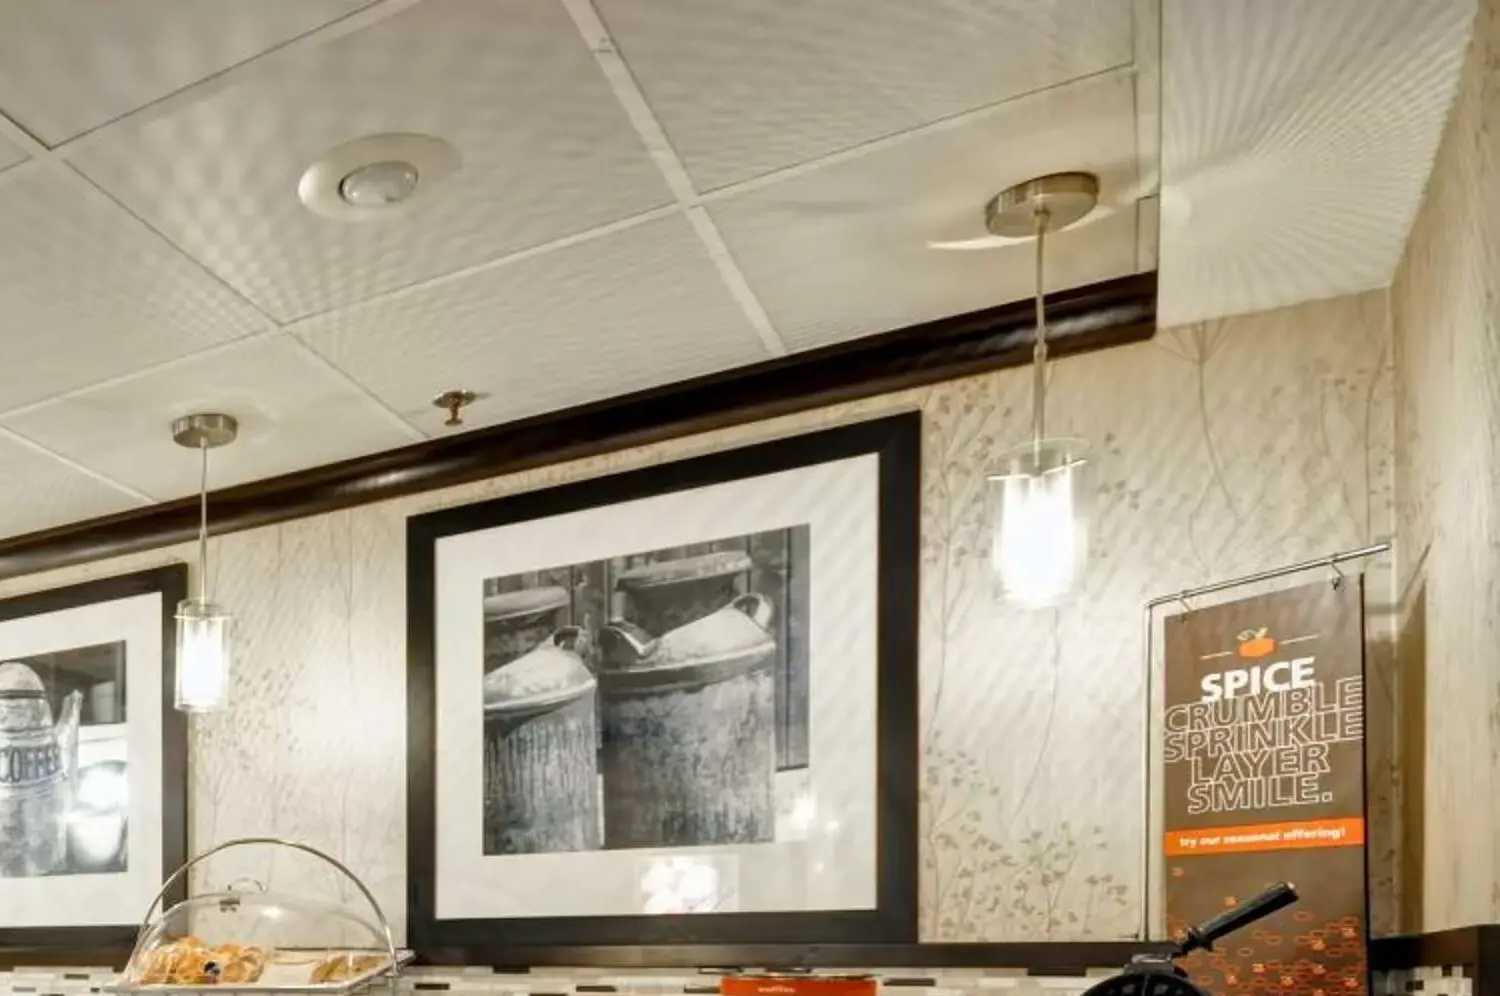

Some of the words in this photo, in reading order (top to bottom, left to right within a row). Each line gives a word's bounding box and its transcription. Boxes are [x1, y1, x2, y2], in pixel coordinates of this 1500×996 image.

[1201, 656, 1316, 703] SPICE
[1165, 675, 1364, 733] CRUMBLE
[1164, 710, 1364, 763] SPRINKLE
[1191, 741, 1331, 785] LAYER
[1187, 771, 1333, 815] SMILE.
[1179, 837, 1197, 849] try
[1200, 835, 1221, 847] our
[1223, 830, 1281, 844] seasonal
[1283, 826, 1346, 842] offering!
